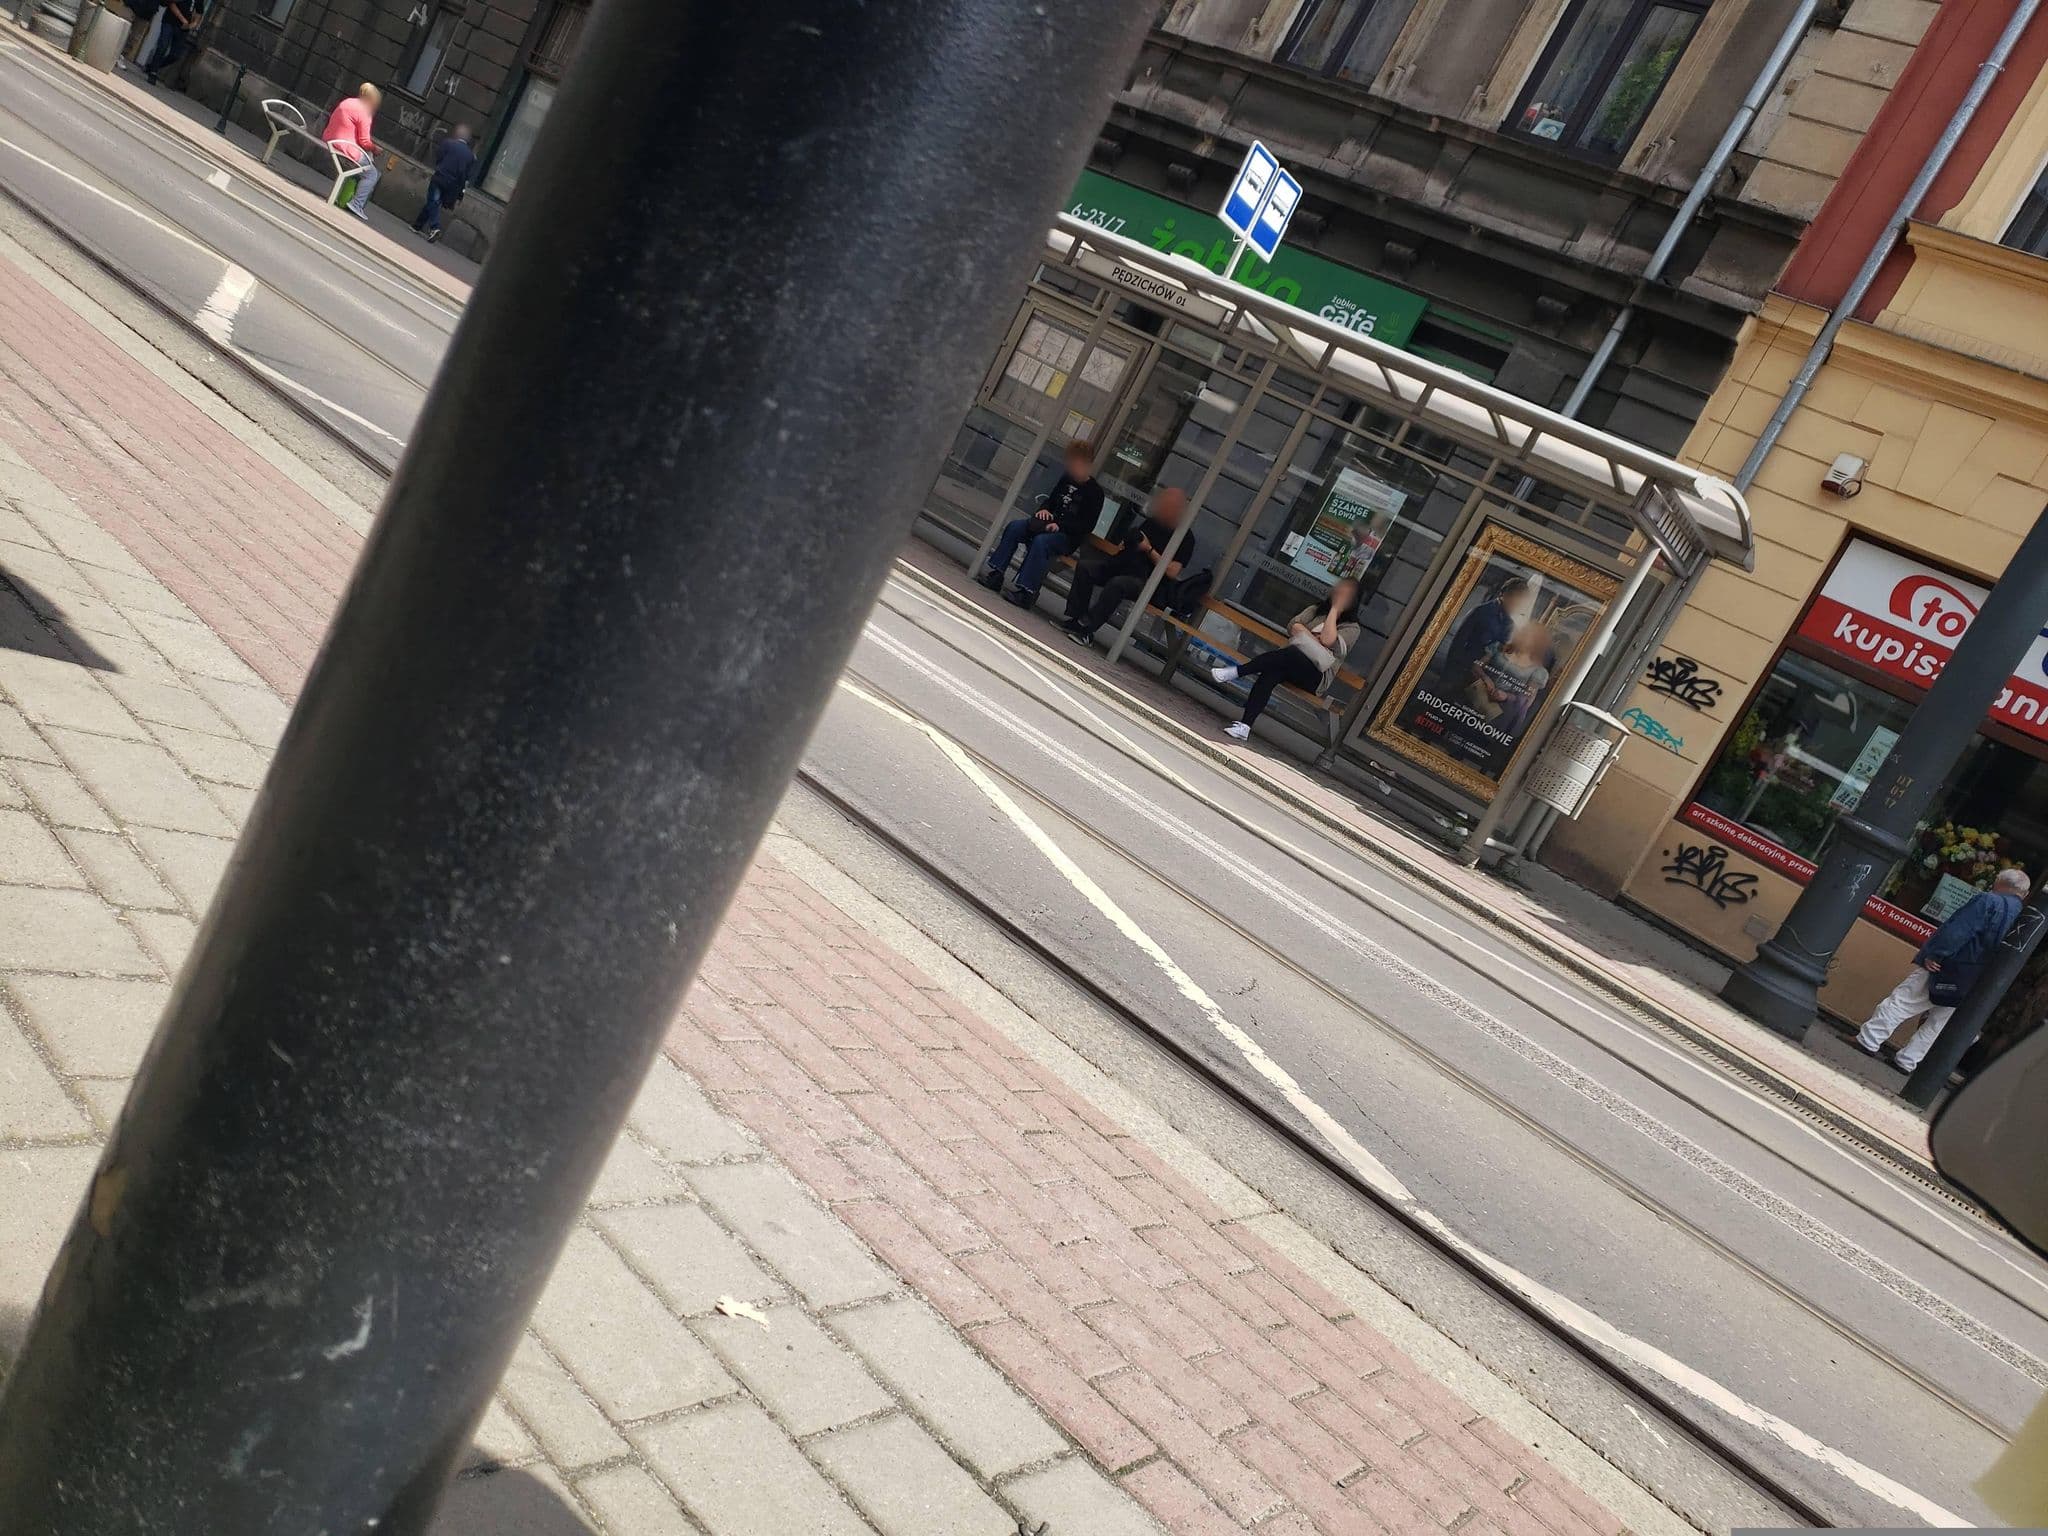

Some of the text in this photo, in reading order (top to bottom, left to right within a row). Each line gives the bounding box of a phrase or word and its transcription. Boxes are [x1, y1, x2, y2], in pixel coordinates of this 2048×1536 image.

[1111, 265, 1188, 308] PĘDZICHÓW 01
[1332, 295, 1356, 311] żabka
[1331, 498, 1370, 518] SZANSE
[1417, 690, 1514, 747] BRIDGERTONOWIE
